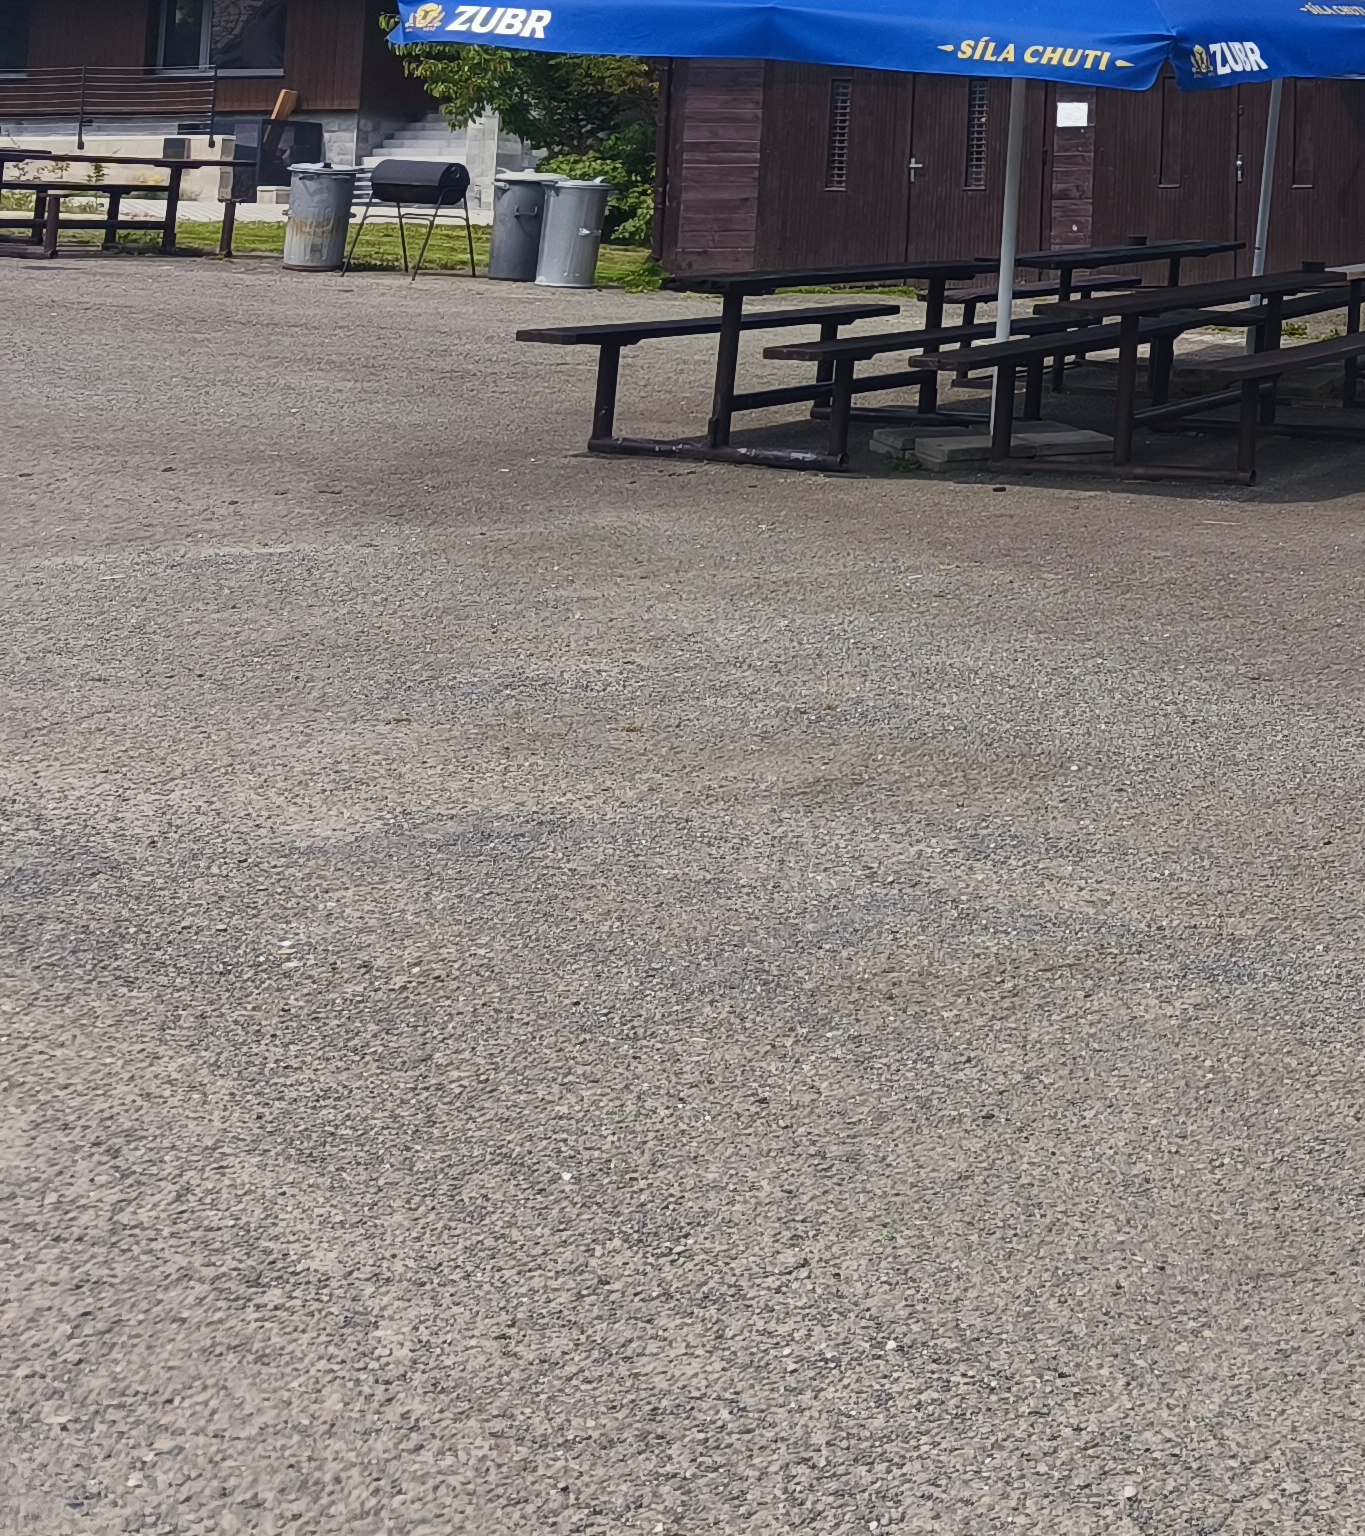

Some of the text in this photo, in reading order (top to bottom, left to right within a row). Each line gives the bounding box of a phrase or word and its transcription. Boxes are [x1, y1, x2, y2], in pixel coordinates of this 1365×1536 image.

[445, 5, 552, 39] ZUBR
[957, 37, 1111, 71] SÍLA CHUTI
[1208, 41, 1269, 75] ZUBR
